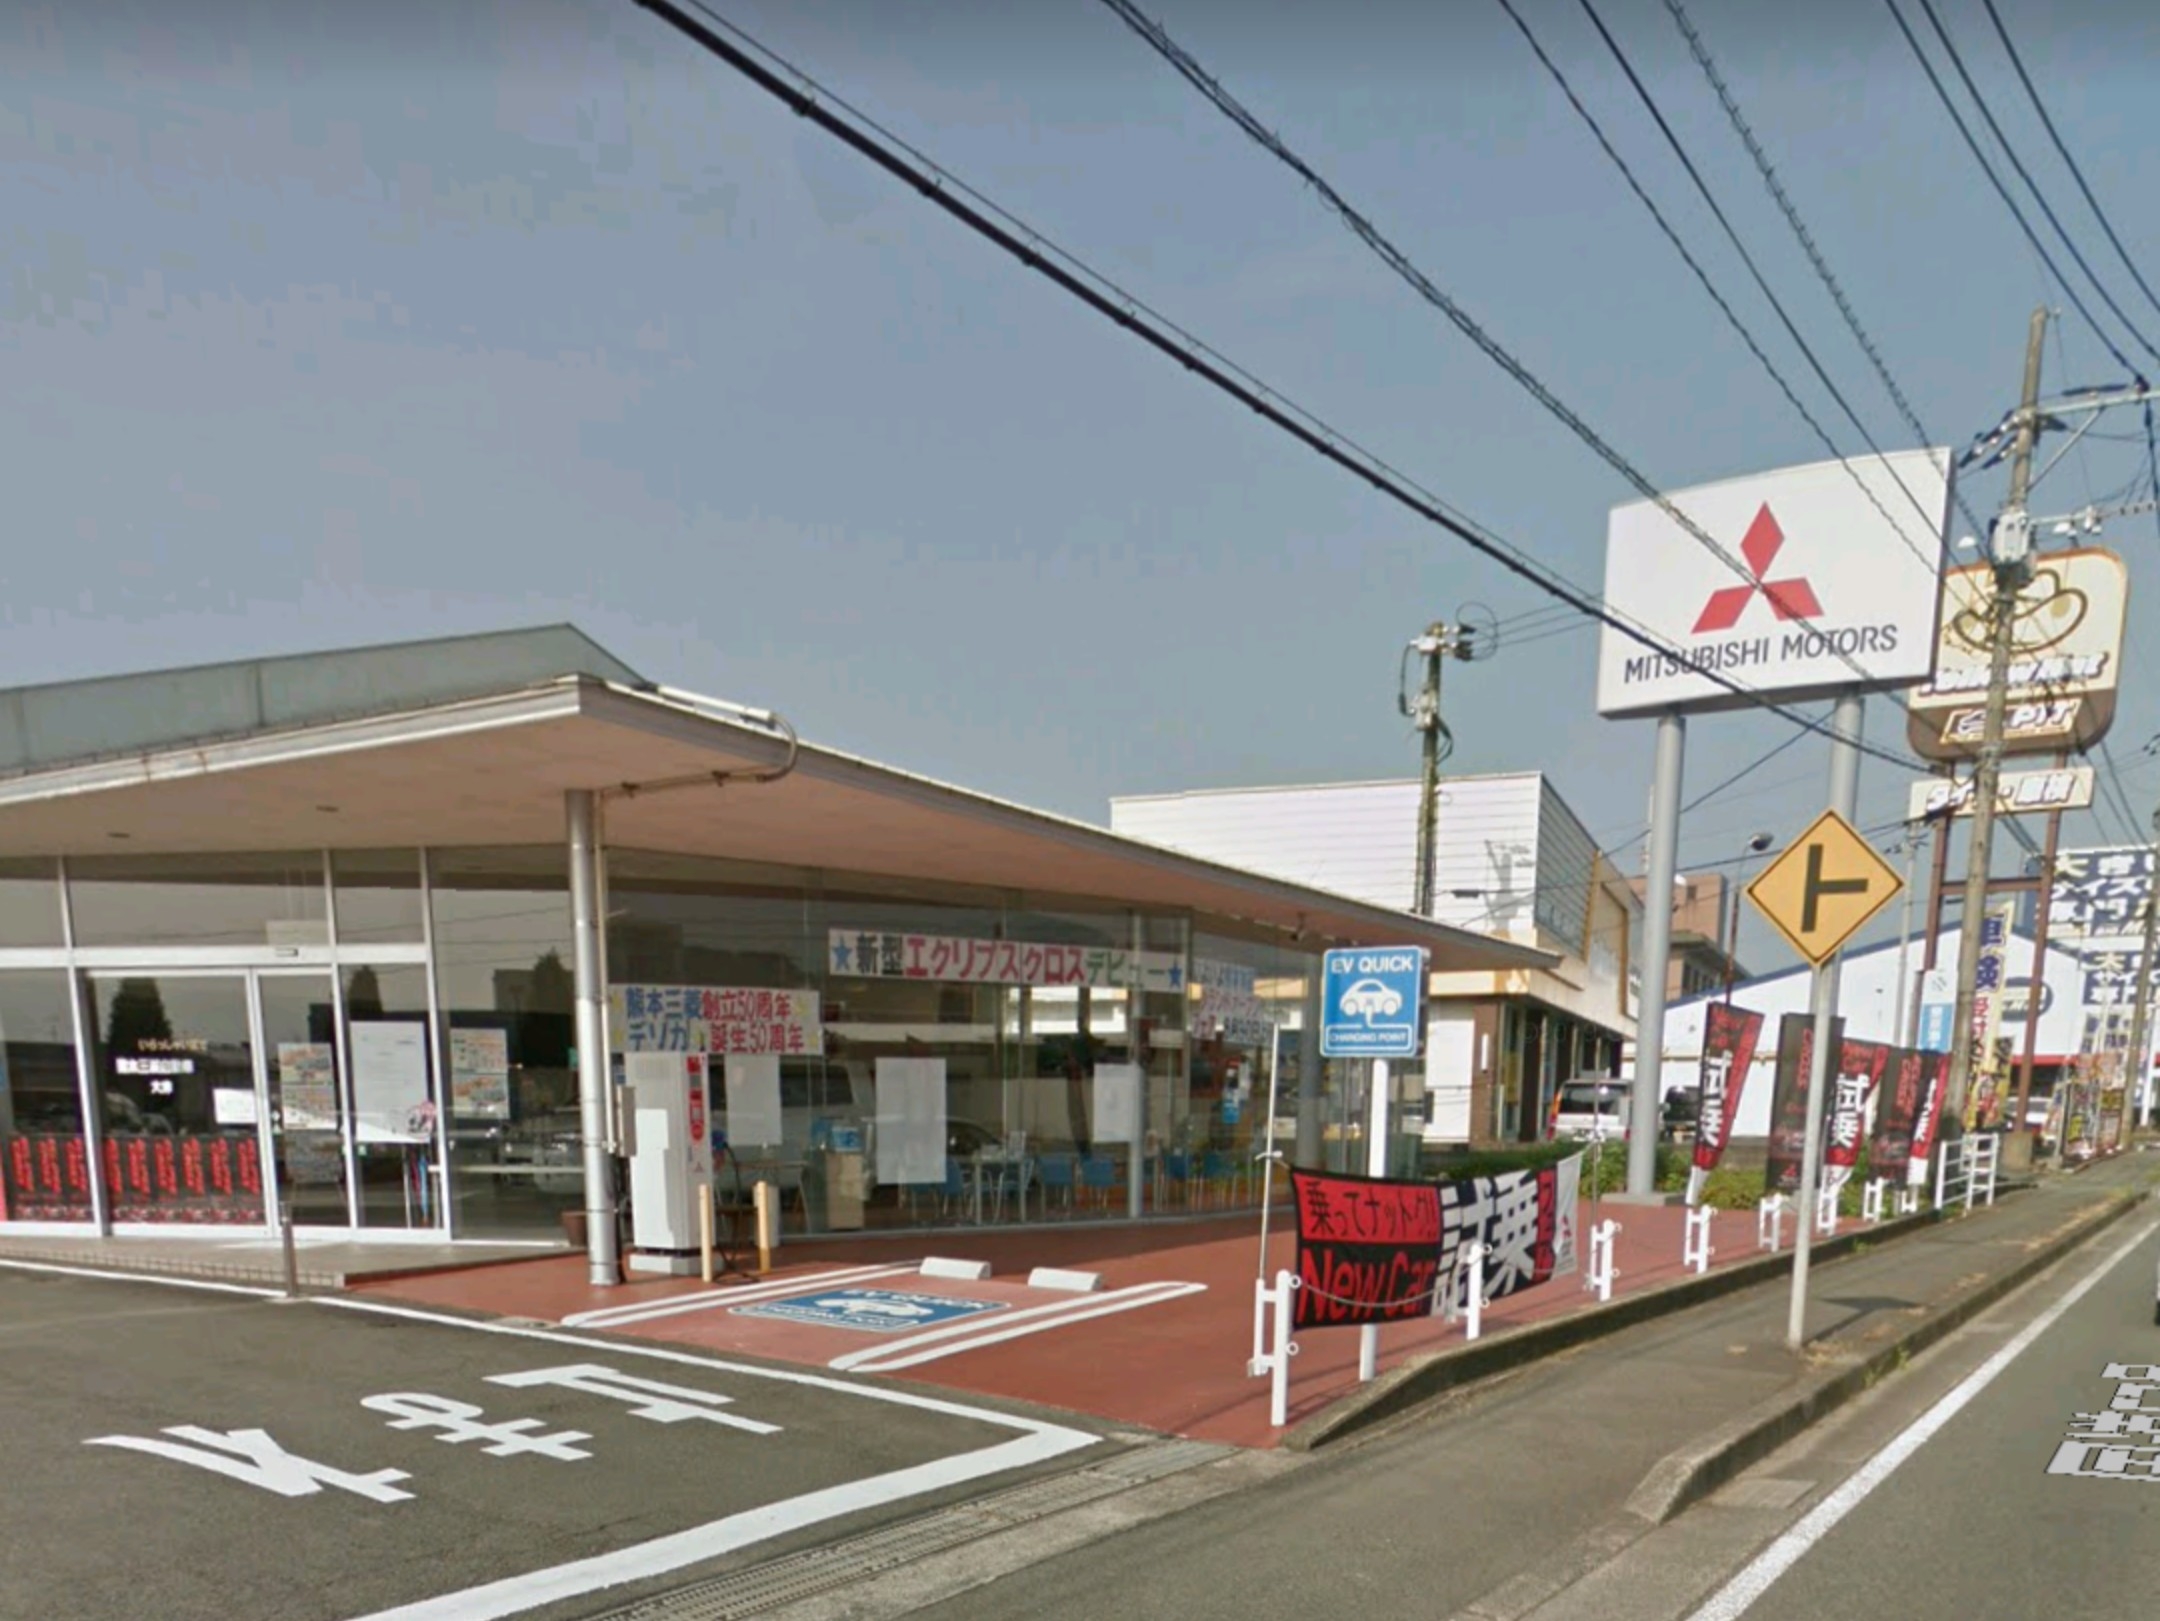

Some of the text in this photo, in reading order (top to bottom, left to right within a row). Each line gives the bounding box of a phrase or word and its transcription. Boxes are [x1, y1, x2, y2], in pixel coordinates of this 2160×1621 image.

[1624, 623, 1898, 684] MITSUBISHI MOTORS
[1331, 954, 1413, 974] EV QUICK
[1297, 1247, 1436, 1324] New Car
[81, 1362, 784, 1503] 止まれ
